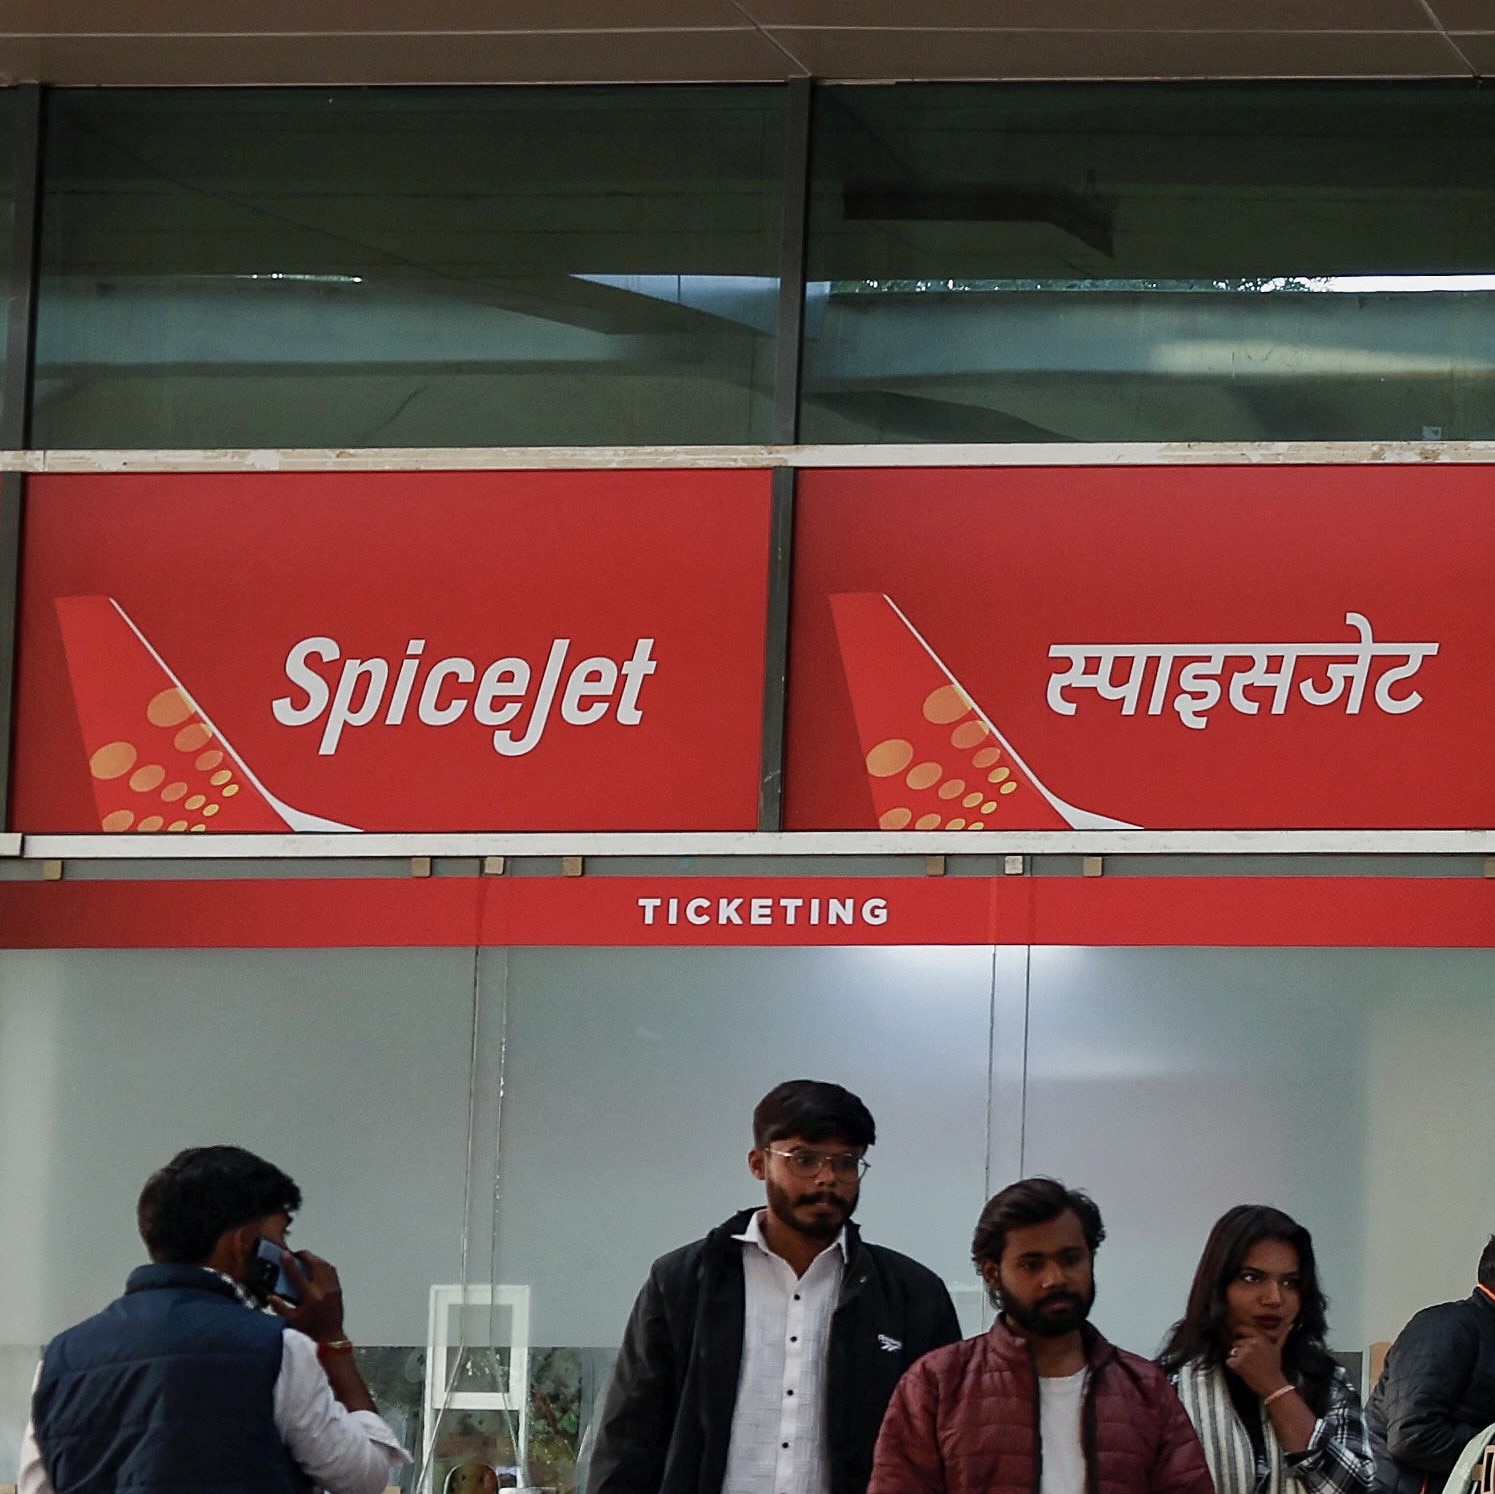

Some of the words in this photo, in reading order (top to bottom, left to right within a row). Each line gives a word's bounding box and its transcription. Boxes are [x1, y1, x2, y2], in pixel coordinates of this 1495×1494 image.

[272, 636, 657, 757] SpiceJet
[1046, 612, 1440, 729] स्पाइसजेट
[637, 897, 888, 925] TICKETING
